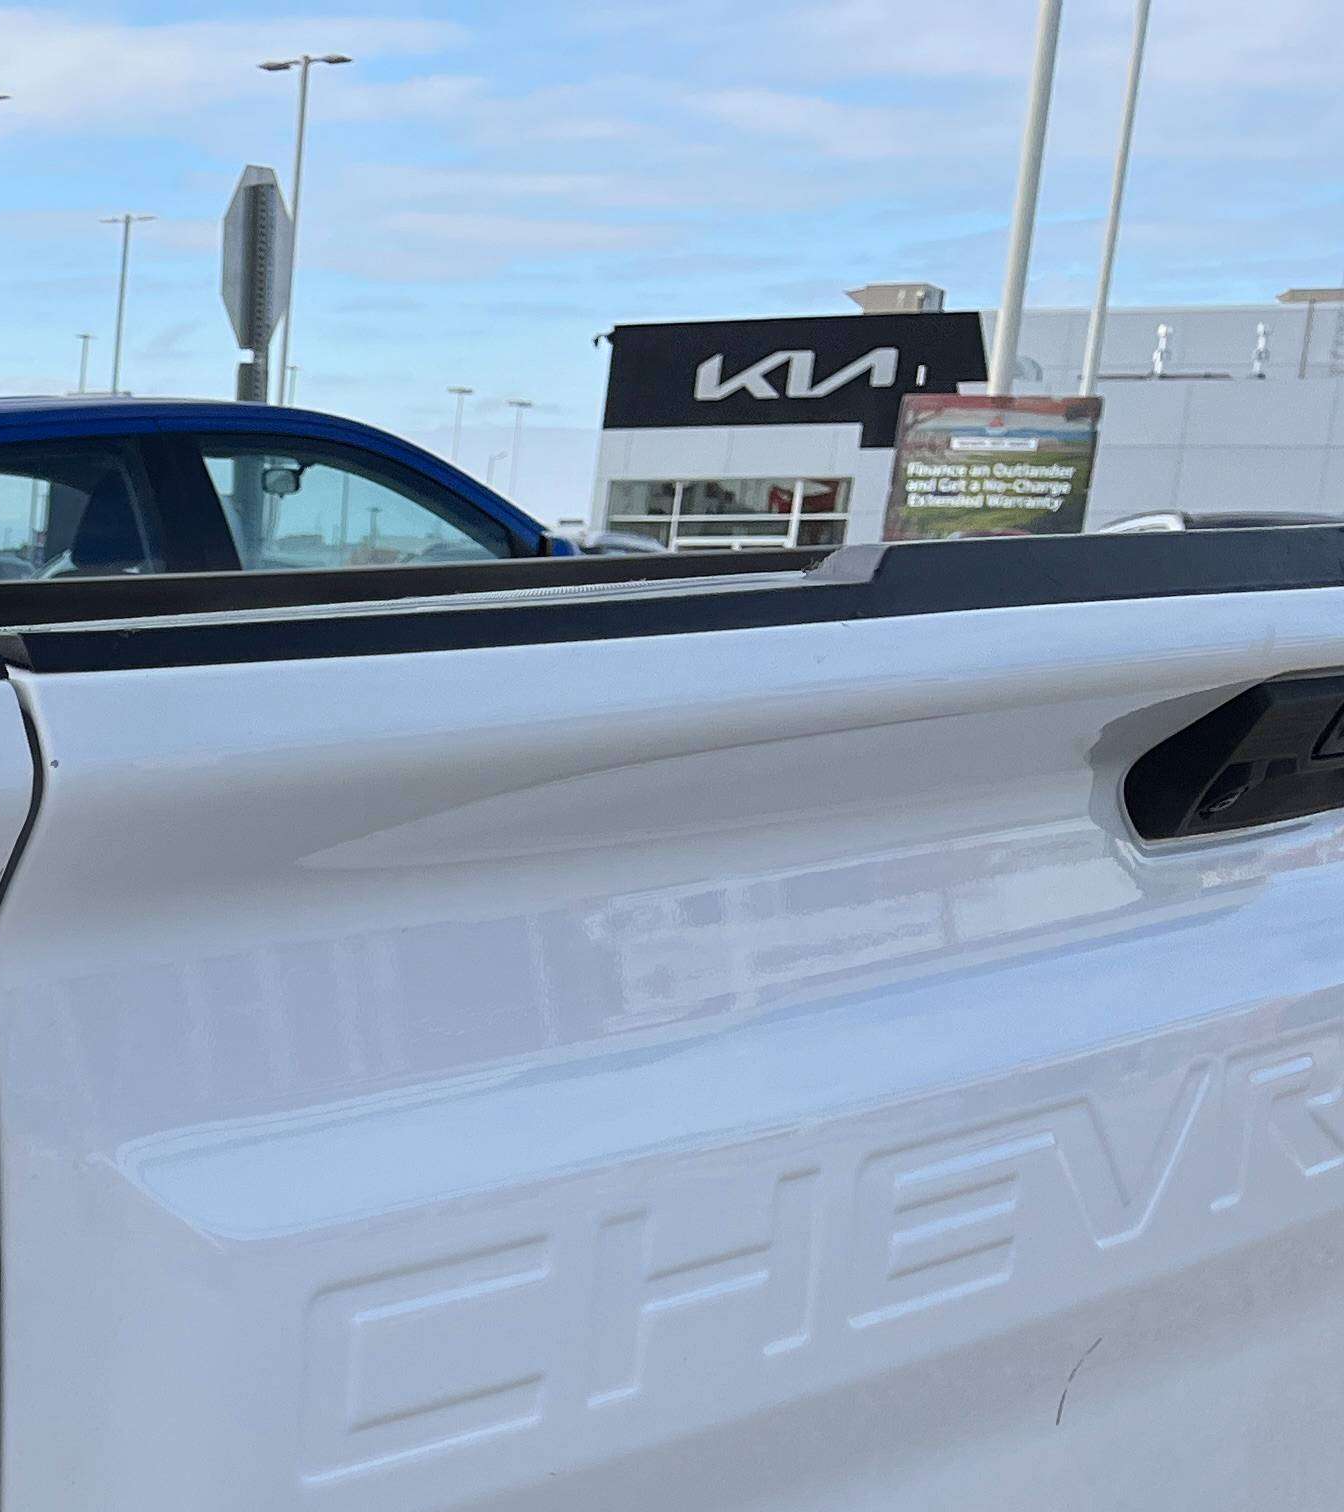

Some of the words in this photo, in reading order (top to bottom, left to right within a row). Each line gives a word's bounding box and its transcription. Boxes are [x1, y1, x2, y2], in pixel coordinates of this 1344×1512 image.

[693, 346, 899, 401] KIA
[906, 462, 967, 478] Finance
[969, 464, 991, 478] an
[993, 462, 1076, 480] Outlander
[905, 478, 937, 493] and
[938, 478, 967, 493] Get
[968, 480, 981, 493] a
[983, 478, 1072, 495] No-Charge
[906, 493, 984, 508] Extended
[986, 494, 1064, 512] Warranty
